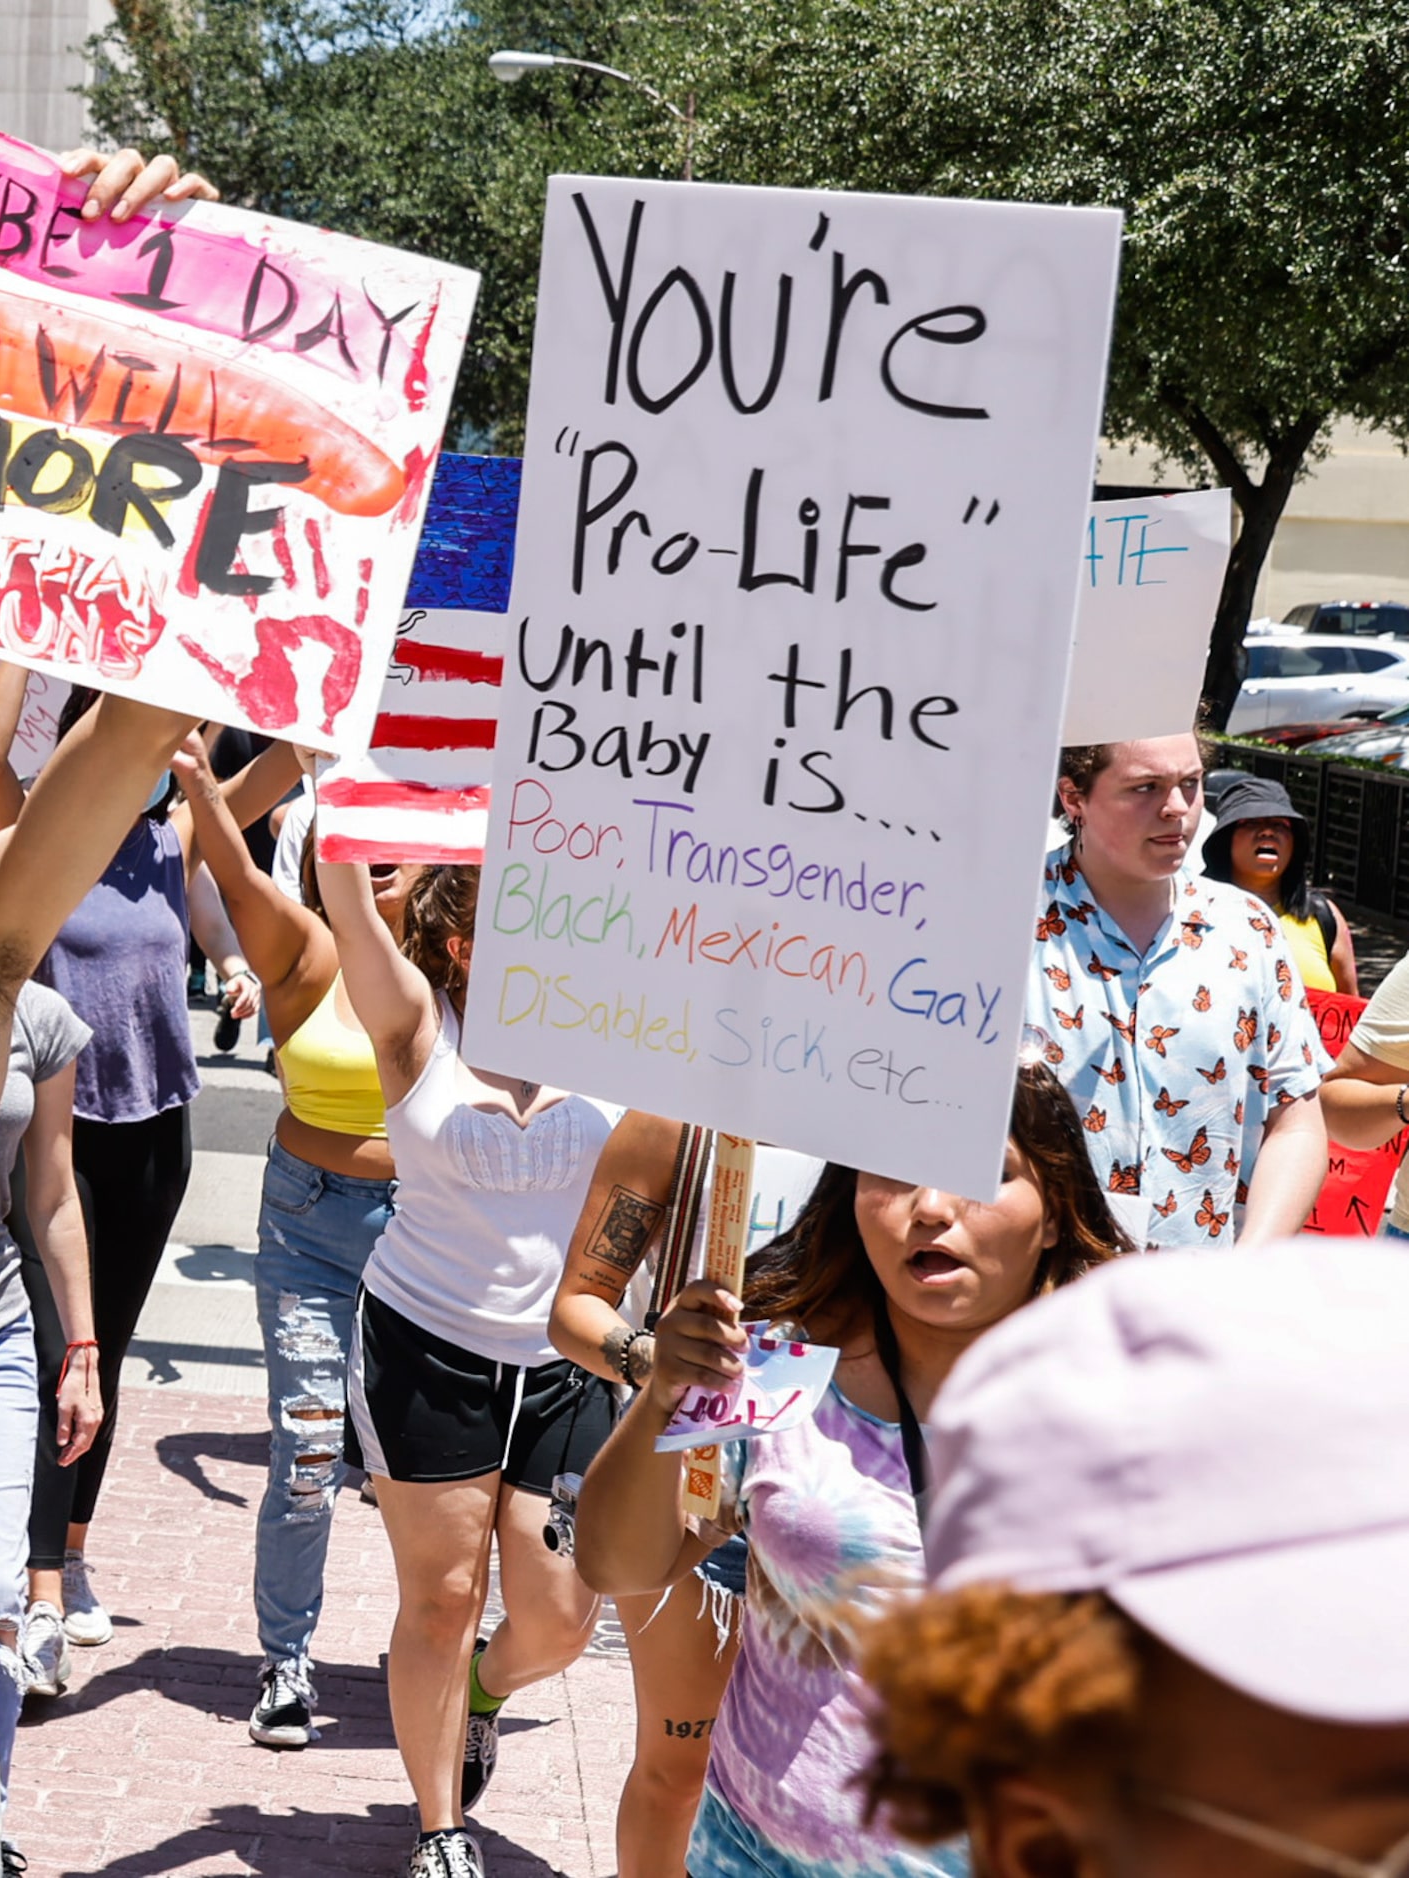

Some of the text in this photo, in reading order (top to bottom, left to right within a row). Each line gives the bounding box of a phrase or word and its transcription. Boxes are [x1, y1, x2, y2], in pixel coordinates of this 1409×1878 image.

[111, 229, 186, 311] 1
[241, 255, 422, 390] DAY
[572, 191, 991, 420] You're
[36, 323, 261, 452] WILL
[528, 701, 712, 794] Baby
[767, 643, 961, 752] the
[508, 779, 929, 930] Poor, Transgender,
[492, 863, 1003, 1046] Black, Mexican, Gay,
[708, 1007, 834, 1083] Sick,
